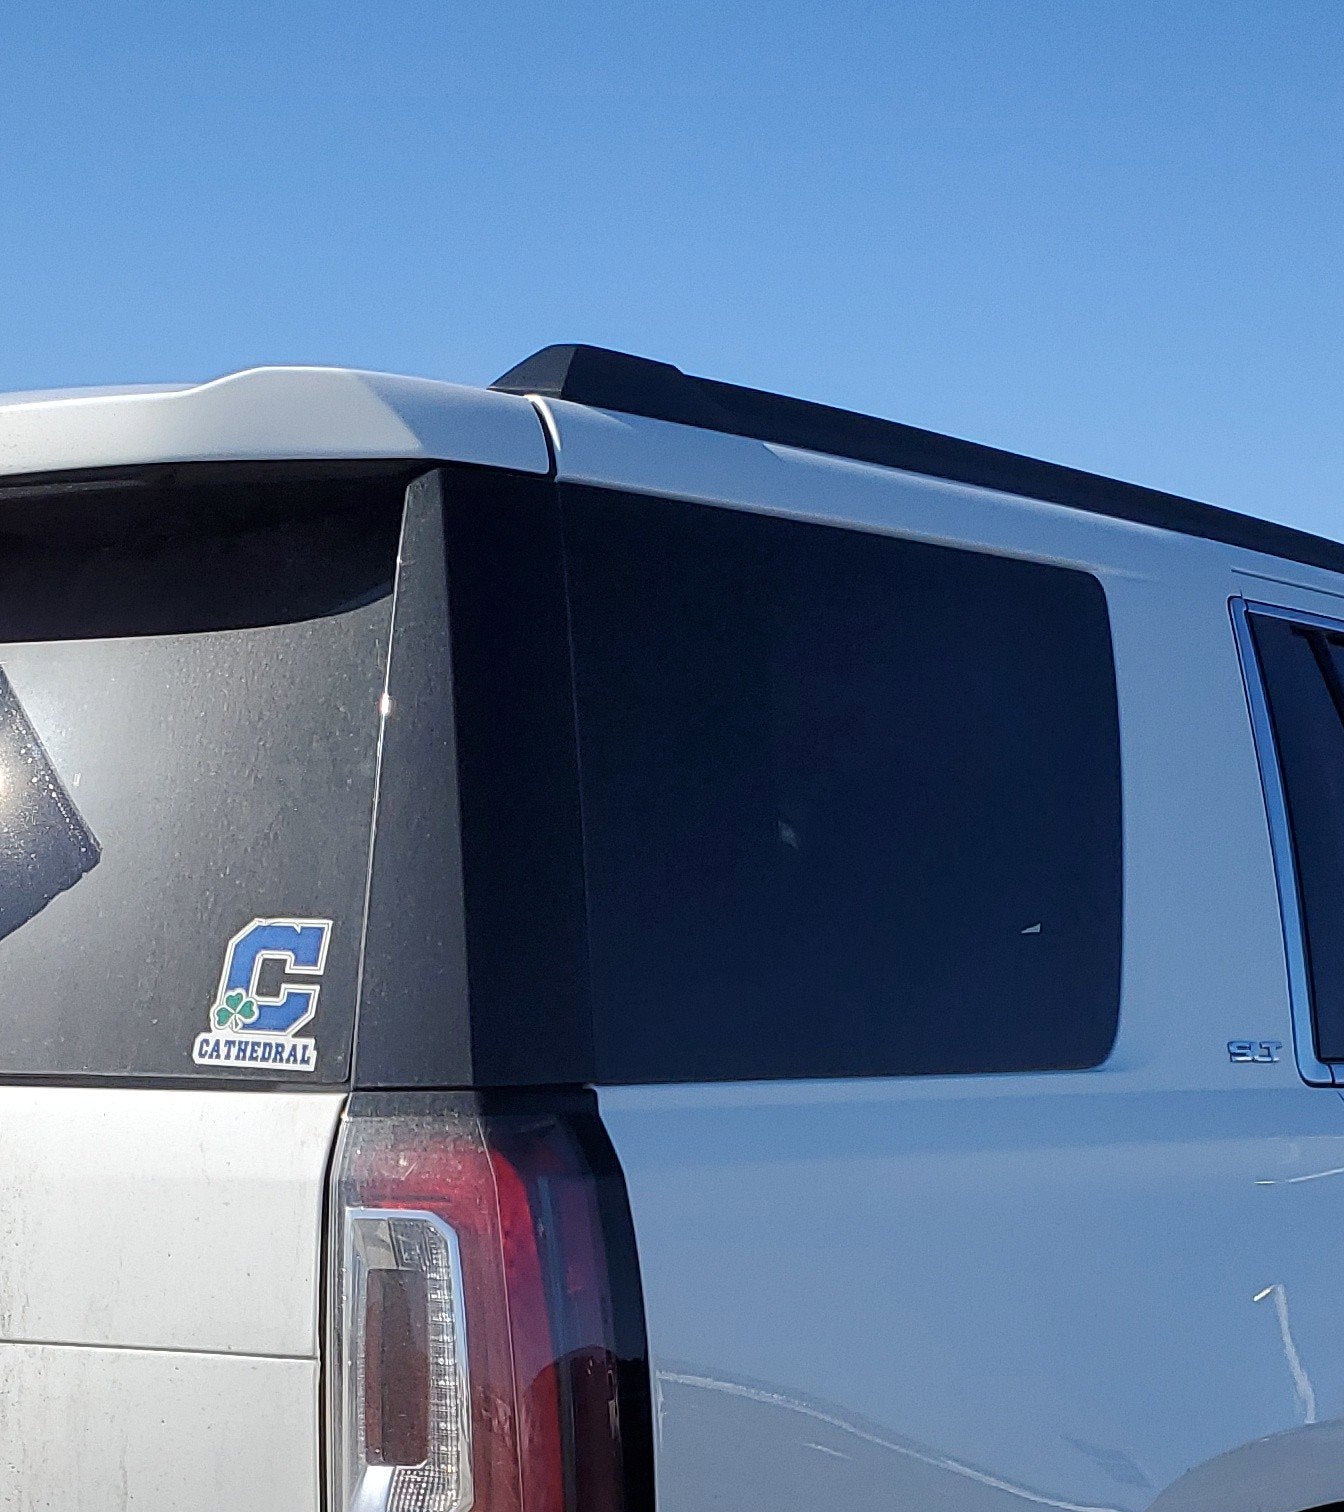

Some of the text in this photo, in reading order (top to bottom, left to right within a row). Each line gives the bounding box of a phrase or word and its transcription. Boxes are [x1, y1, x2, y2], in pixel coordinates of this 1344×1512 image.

[219, 918, 333, 1034] C
[198, 1038, 312, 1066] CATHEDRAL
[1227, 1040, 1283, 1063] SLT
